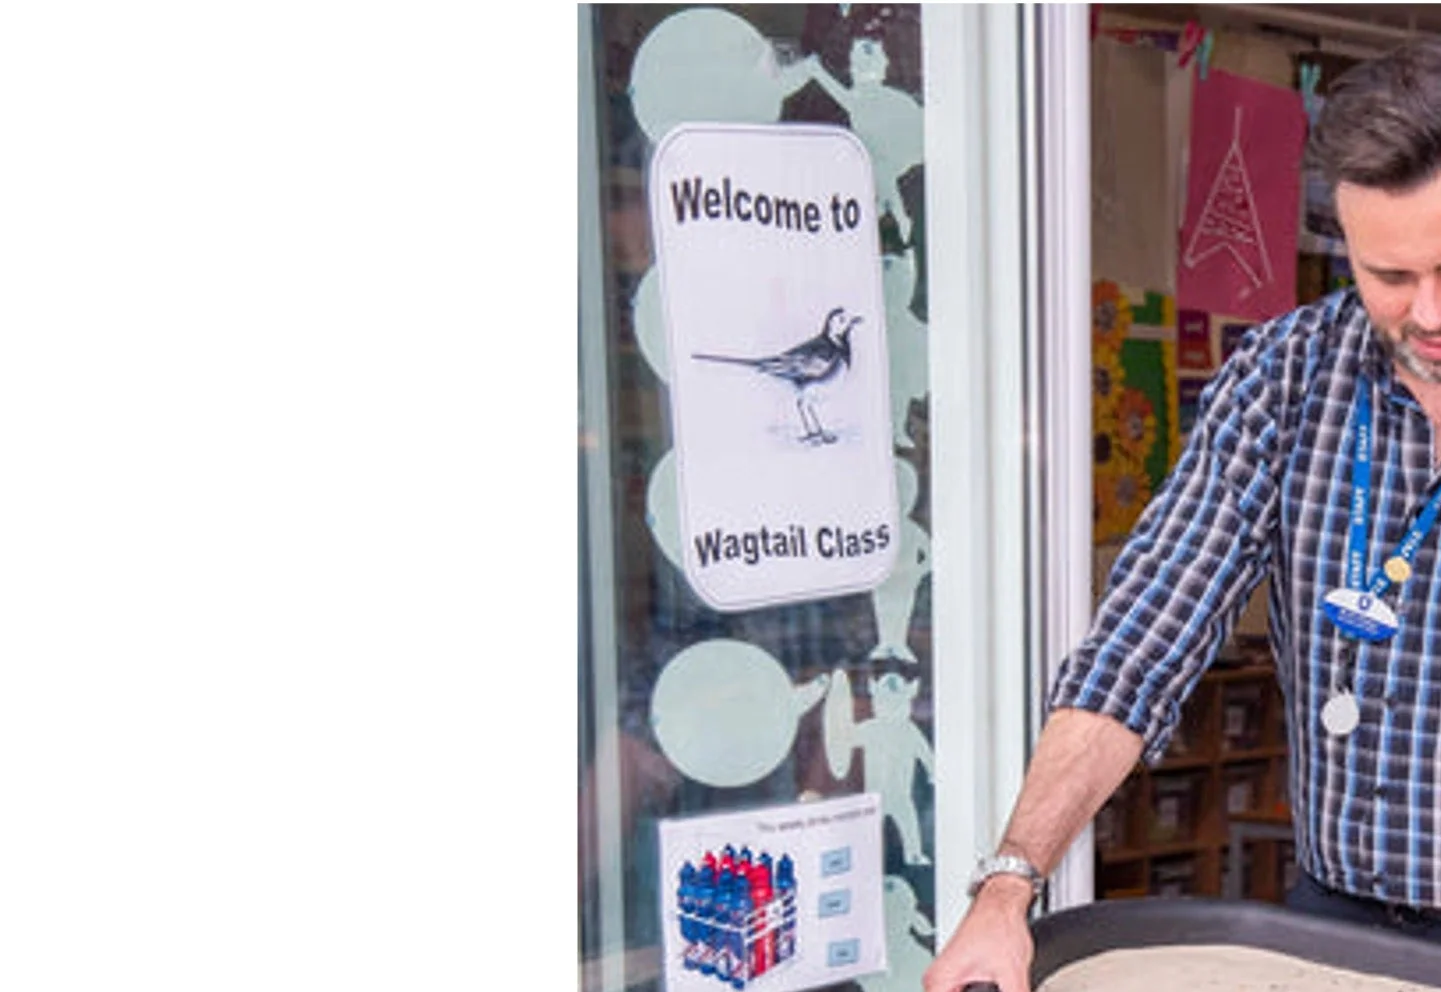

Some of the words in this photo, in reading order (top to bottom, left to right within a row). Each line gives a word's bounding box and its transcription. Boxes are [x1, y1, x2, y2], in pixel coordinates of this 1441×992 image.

[671, 178, 820, 233] Welcome
[832, 194, 861, 232] to
[694, 524, 806, 568] Wagtail
[817, 522, 891, 558] Class
